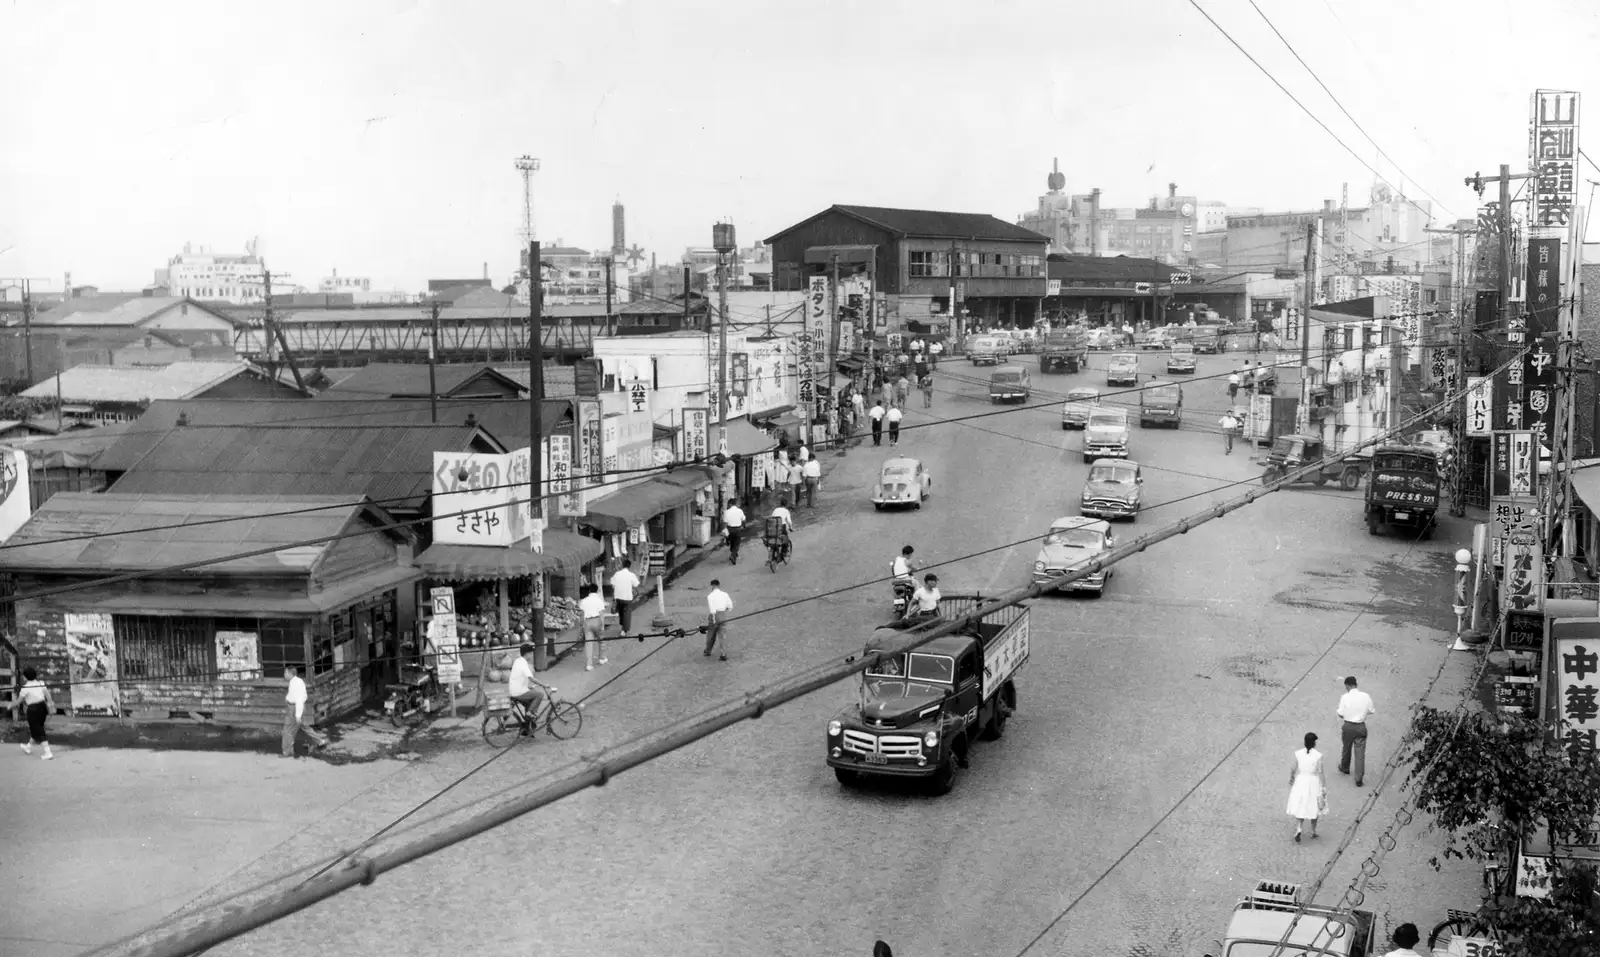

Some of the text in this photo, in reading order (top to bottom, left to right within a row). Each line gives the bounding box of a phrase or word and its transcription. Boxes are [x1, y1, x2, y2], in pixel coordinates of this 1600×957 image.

[1474, 400, 1486, 430] ハトリ
[1386, 491, 1421, 501] PRESS
[457, 507, 500, 535] ささや
